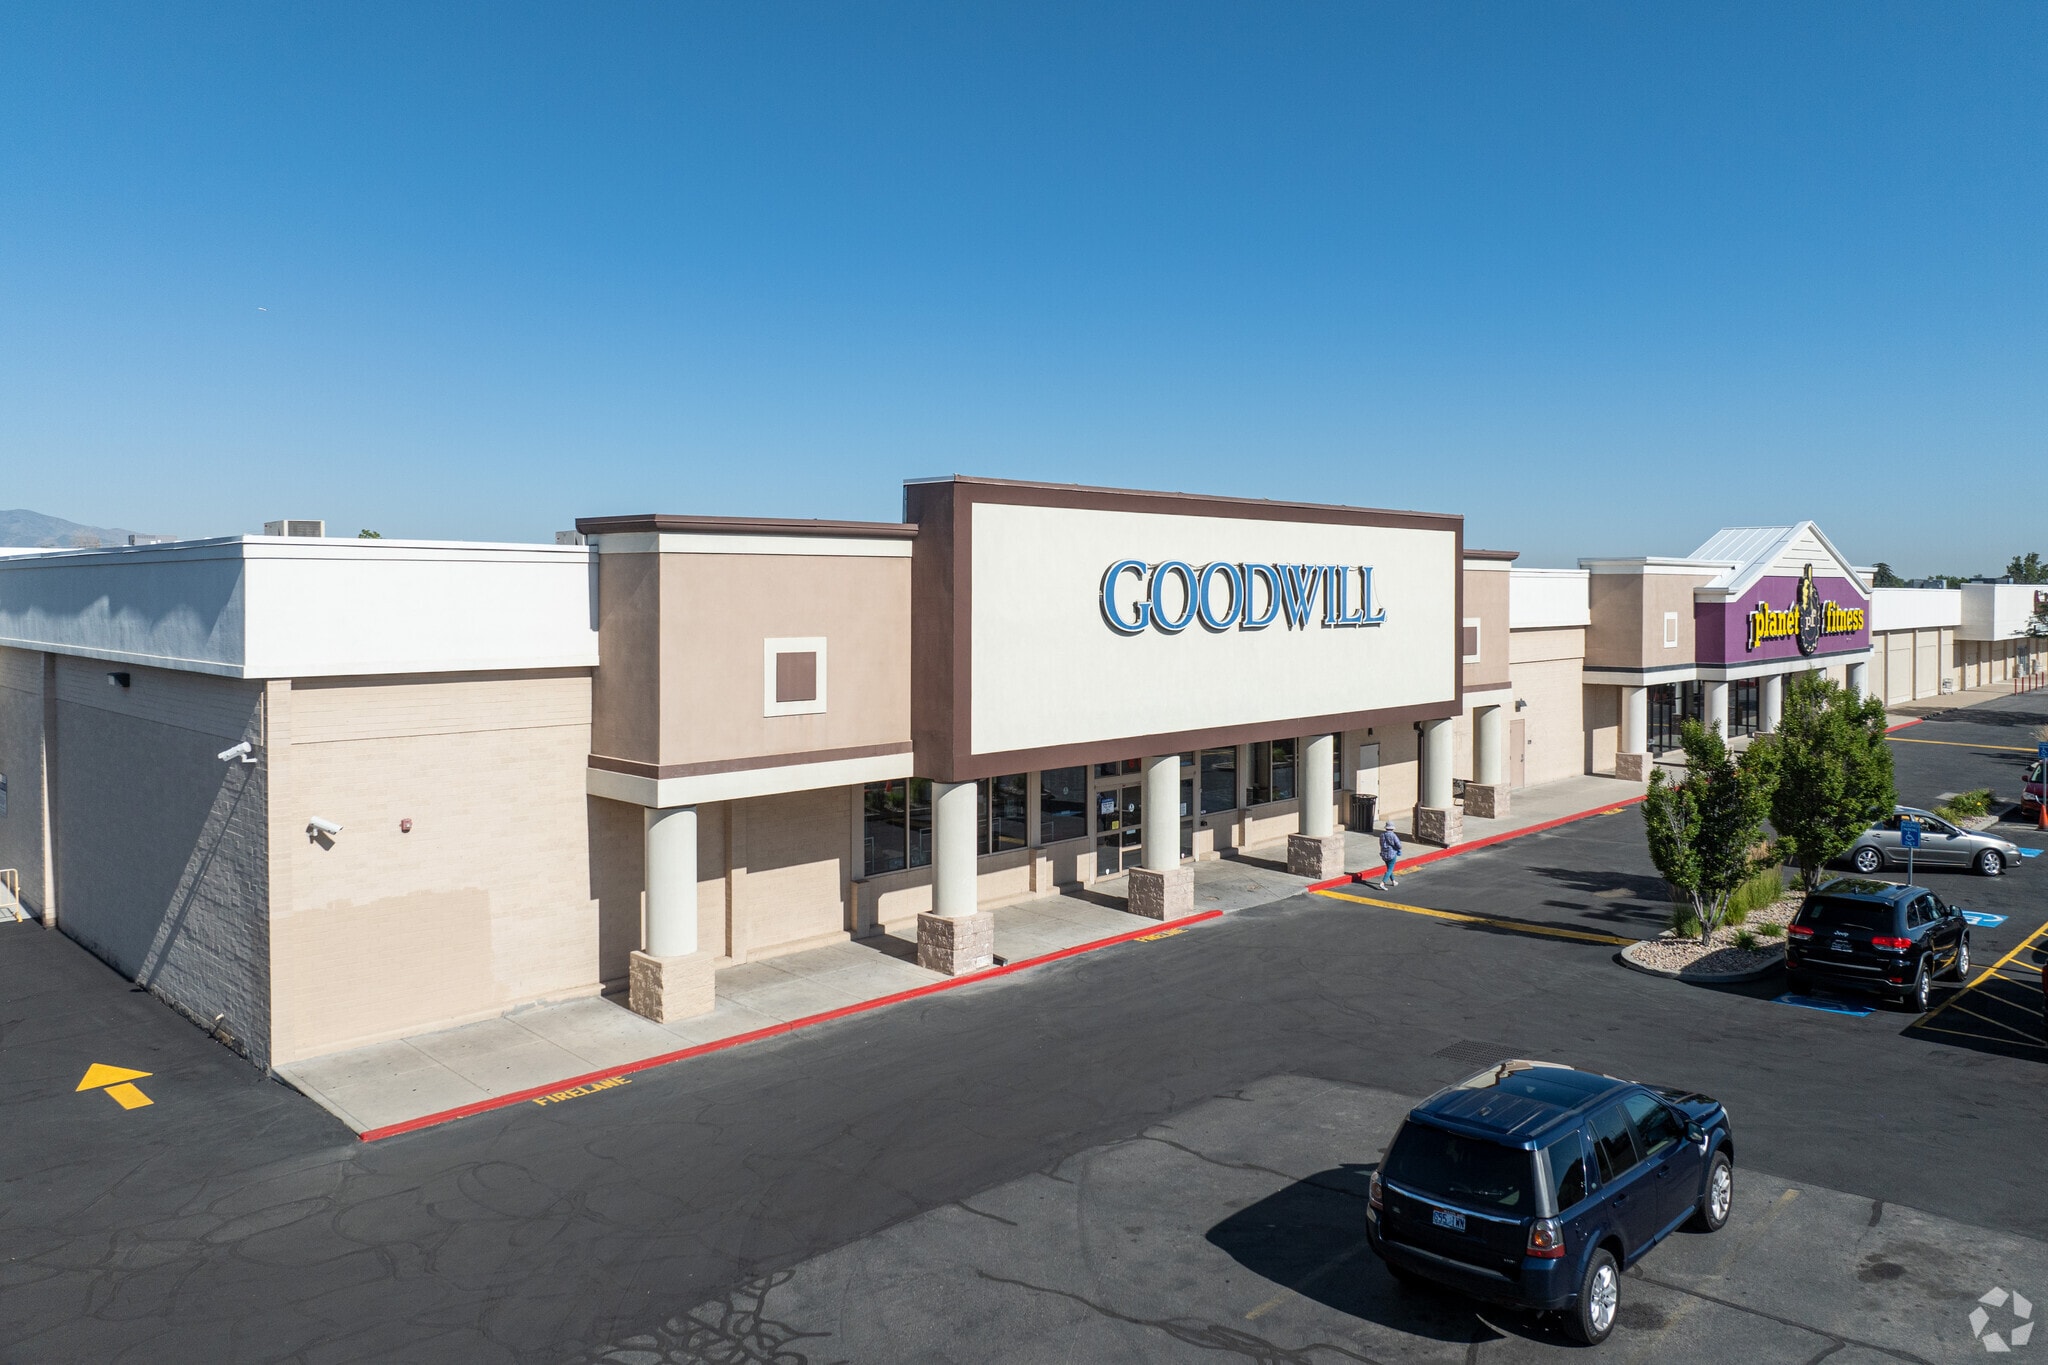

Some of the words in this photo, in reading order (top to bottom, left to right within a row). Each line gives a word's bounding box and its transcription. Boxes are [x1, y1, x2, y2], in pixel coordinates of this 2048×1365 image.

[1101, 558, 1386, 634] GOODWILL
[1750, 601, 1799, 648] planet
[1823, 600, 1864, 633] fitness
